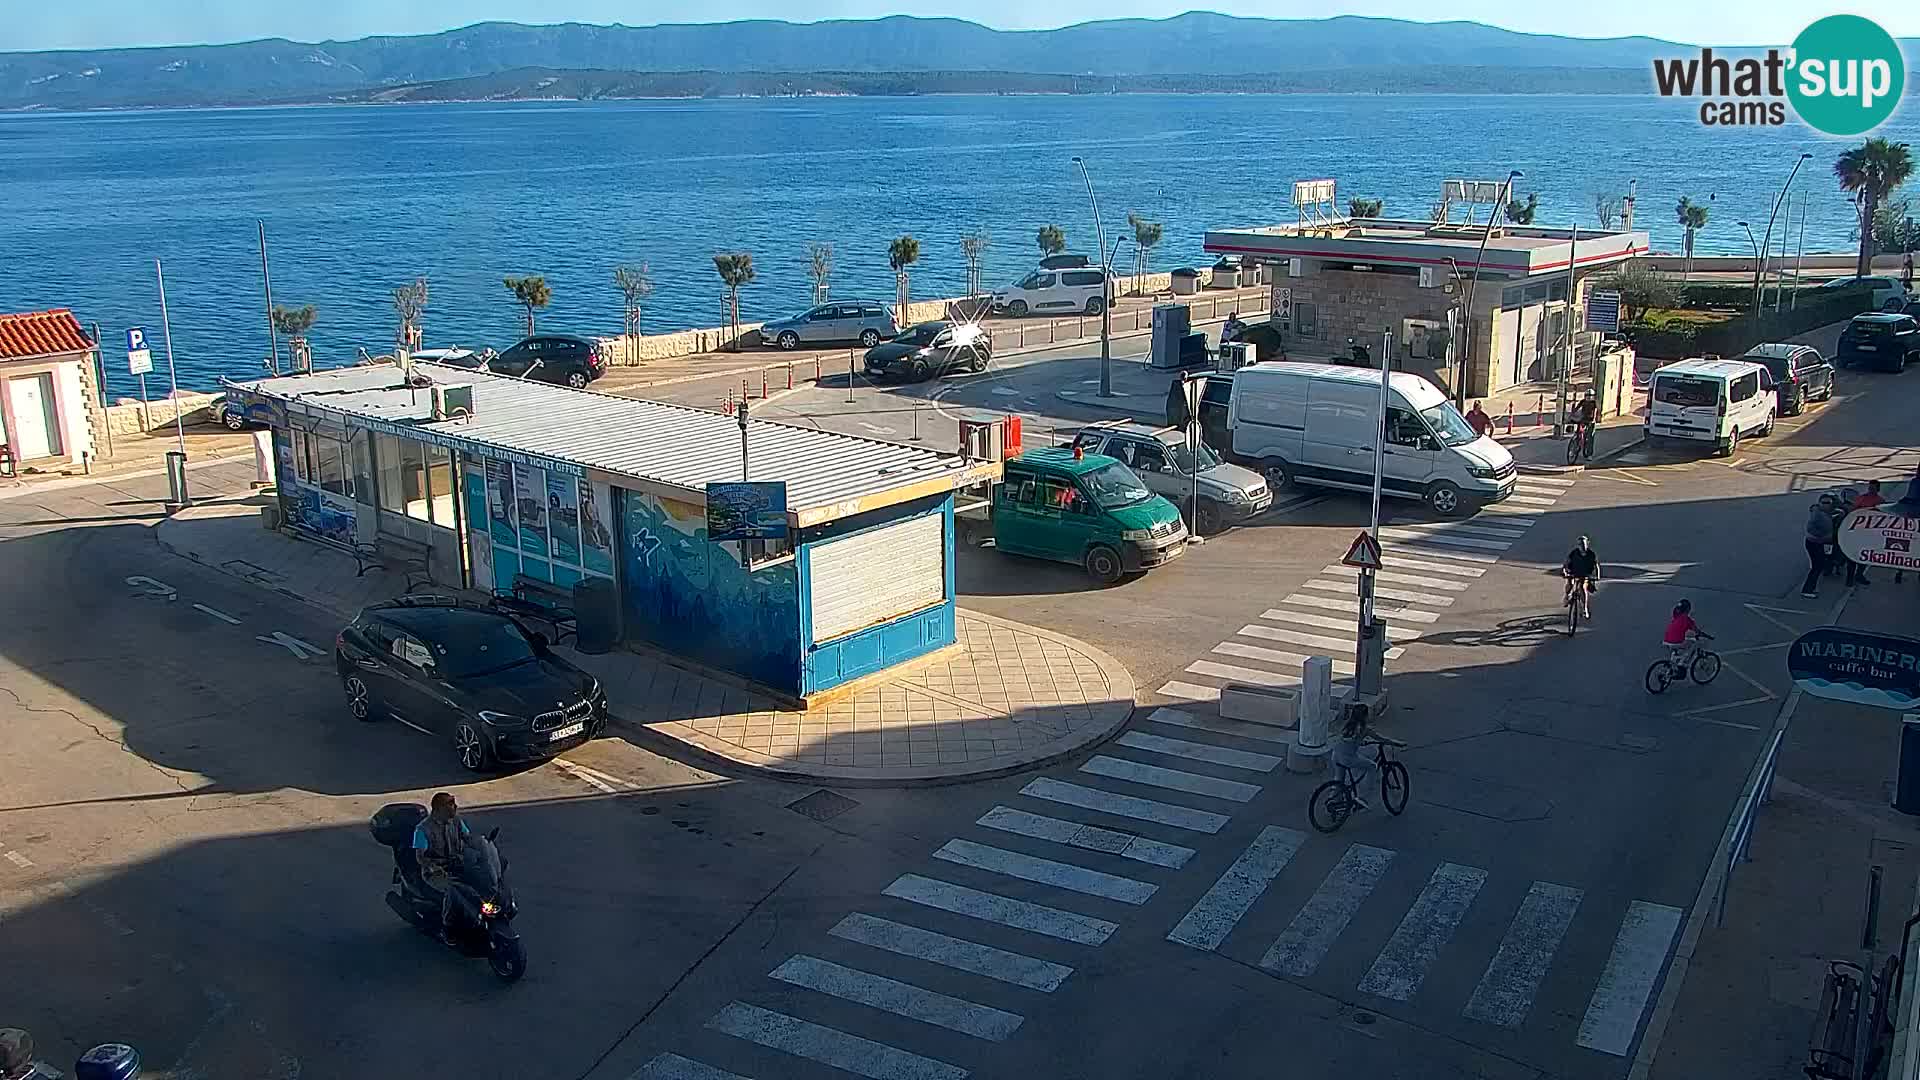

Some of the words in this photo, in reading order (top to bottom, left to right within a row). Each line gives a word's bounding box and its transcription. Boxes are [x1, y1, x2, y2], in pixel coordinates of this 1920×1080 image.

[479, 445, 493, 456] BUS
[494, 448, 526, 464] STATION
[527, 456, 554, 471] TICKET
[556, 460, 583, 476] OFFICE
[1870, 666, 1897, 679] bar
